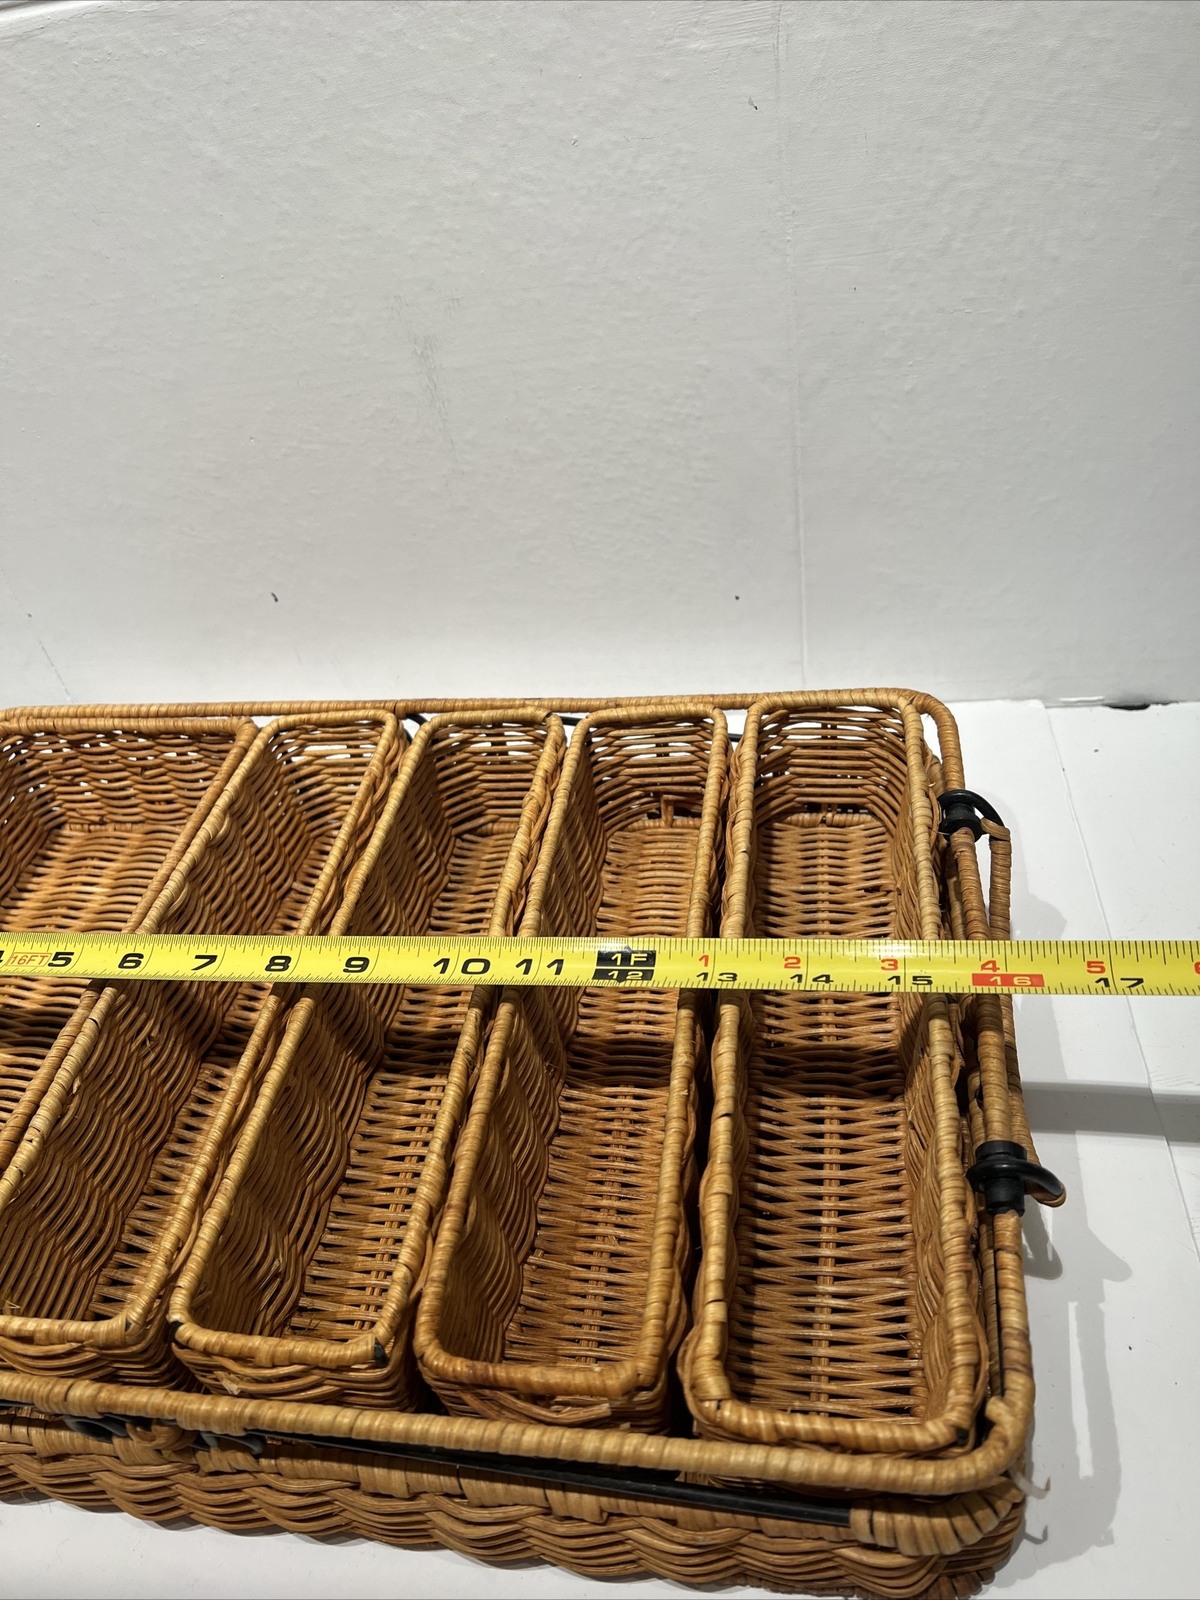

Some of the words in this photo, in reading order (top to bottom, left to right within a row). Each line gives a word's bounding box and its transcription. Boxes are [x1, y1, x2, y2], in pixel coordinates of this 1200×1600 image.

[11, 954, 50, 966] 16FT
[47, 951, 75, 968] 5
[117, 953, 145, 969] 6
[190, 954, 218, 971] 7
[264, 955, 292, 972] 8
[342, 956, 371, 973] 9
[432, 957, 491, 975] 10
[515, 958, 565, 976] 11
[610, 953, 648, 966] 1F
[698, 954, 710, 967] 1
[783, 956, 802, 969] 2
[880, 958, 899, 971] 3
[980, 959, 1001, 973] 4
[1086, 960, 1106, 974] 5
[607, 970, 643, 980] 12
[696, 972, 738, 982] 13
[789, 973, 835, 984] 14
[887, 975, 934, 986] 15
[989, 976, 1033, 986] 16
[1094, 977, 1145, 989] 17
